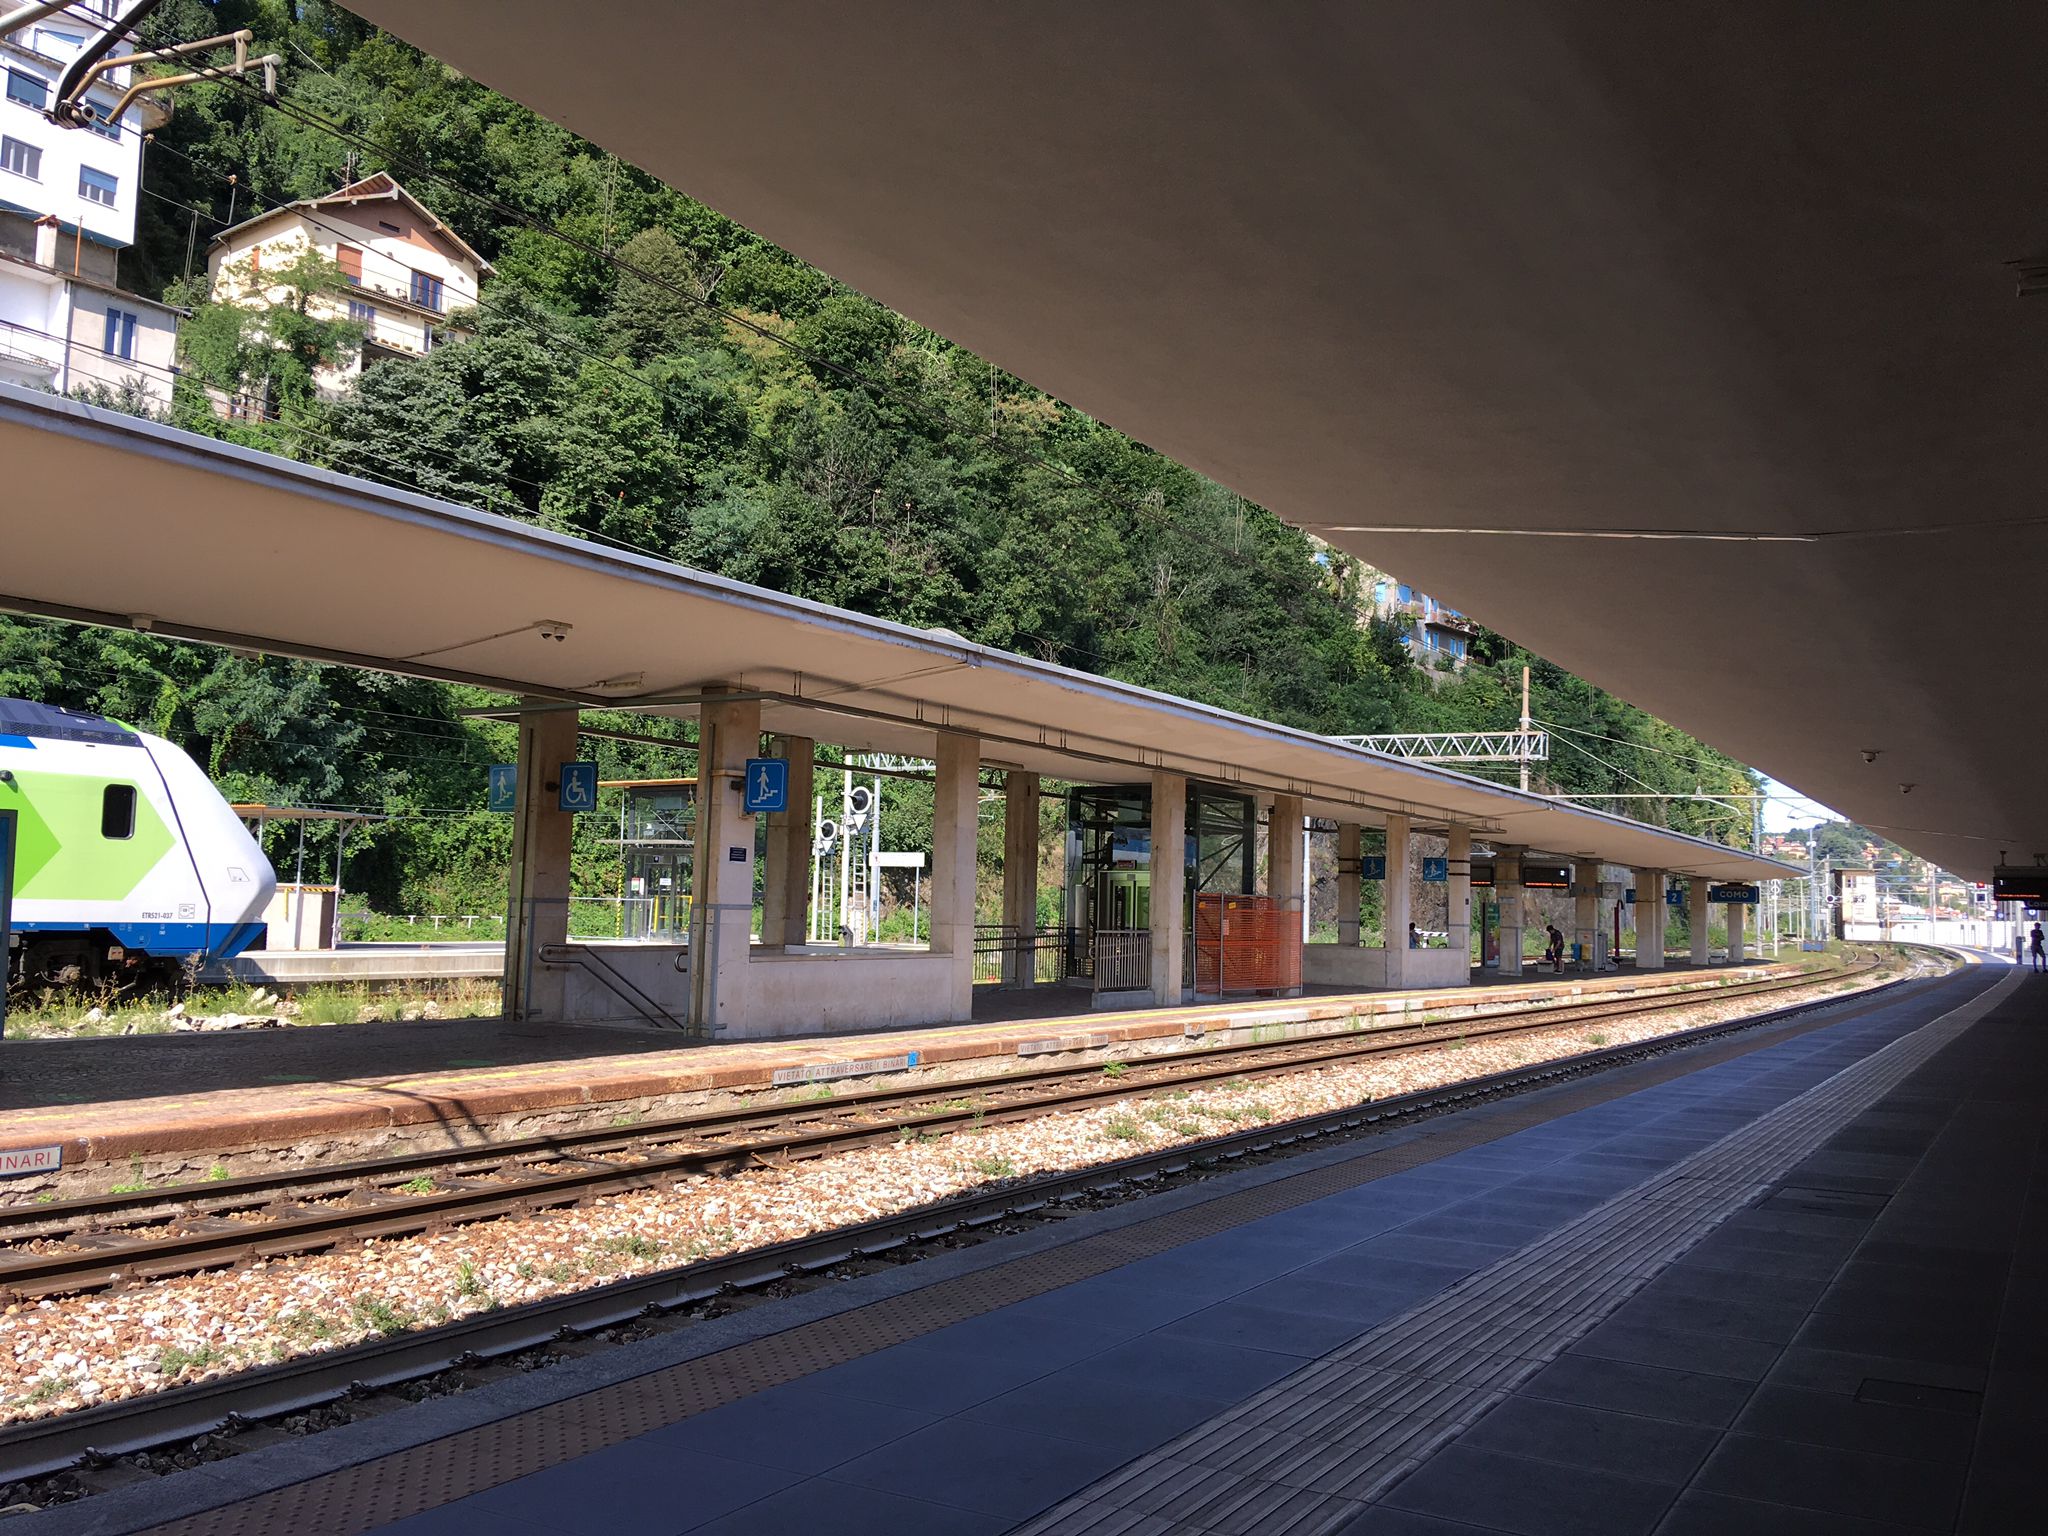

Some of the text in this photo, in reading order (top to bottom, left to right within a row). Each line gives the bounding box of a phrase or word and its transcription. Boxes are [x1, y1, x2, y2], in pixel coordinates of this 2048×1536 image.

[1671, 893, 1677, 902] 2
[778, 1070, 811, 1081] VIETATO
[815, 1061, 873, 1077] ATTRAVERSARE
[883, 1058, 906, 1069] BINARI
